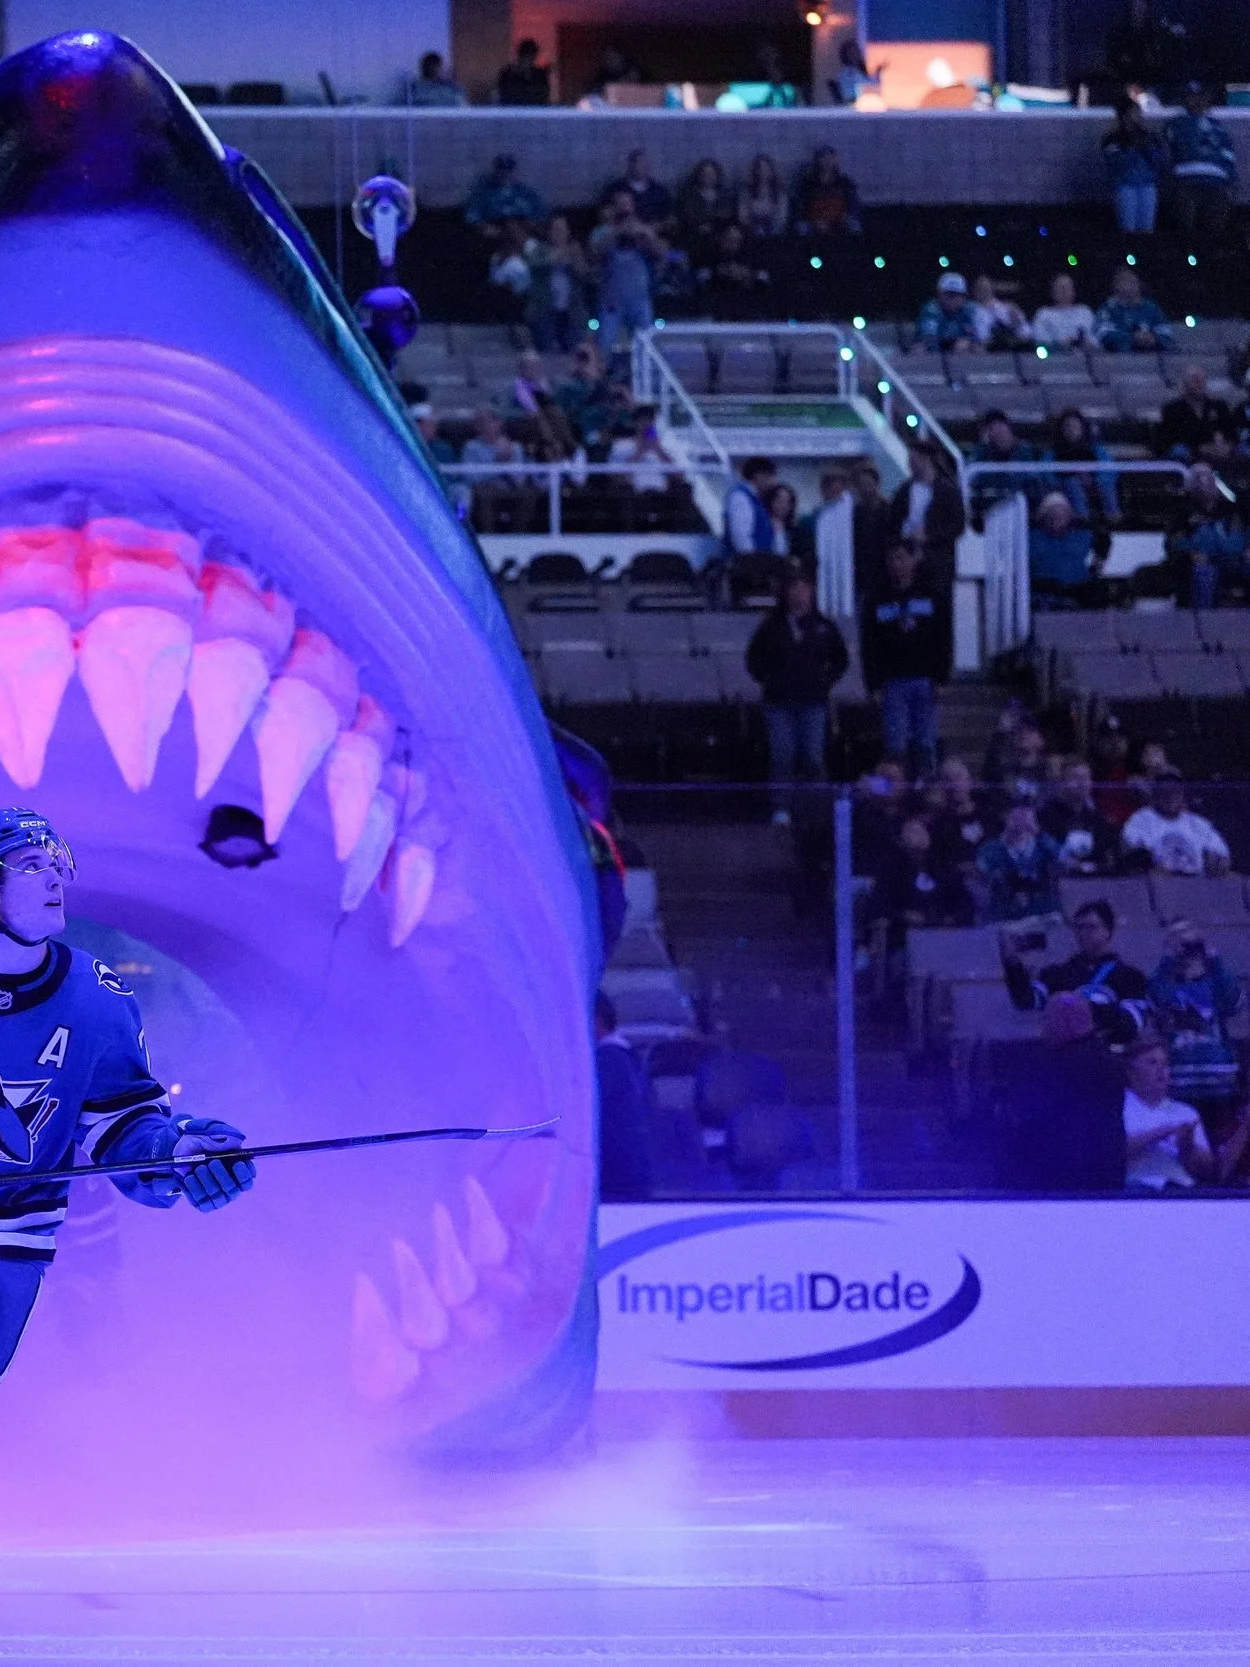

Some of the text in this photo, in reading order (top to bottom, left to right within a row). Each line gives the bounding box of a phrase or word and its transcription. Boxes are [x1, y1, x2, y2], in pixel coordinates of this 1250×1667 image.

[20, 820, 47, 829] CCM
[37, 1026, 69, 1069] A
[617, 1271, 930, 1323] ImperialDade
